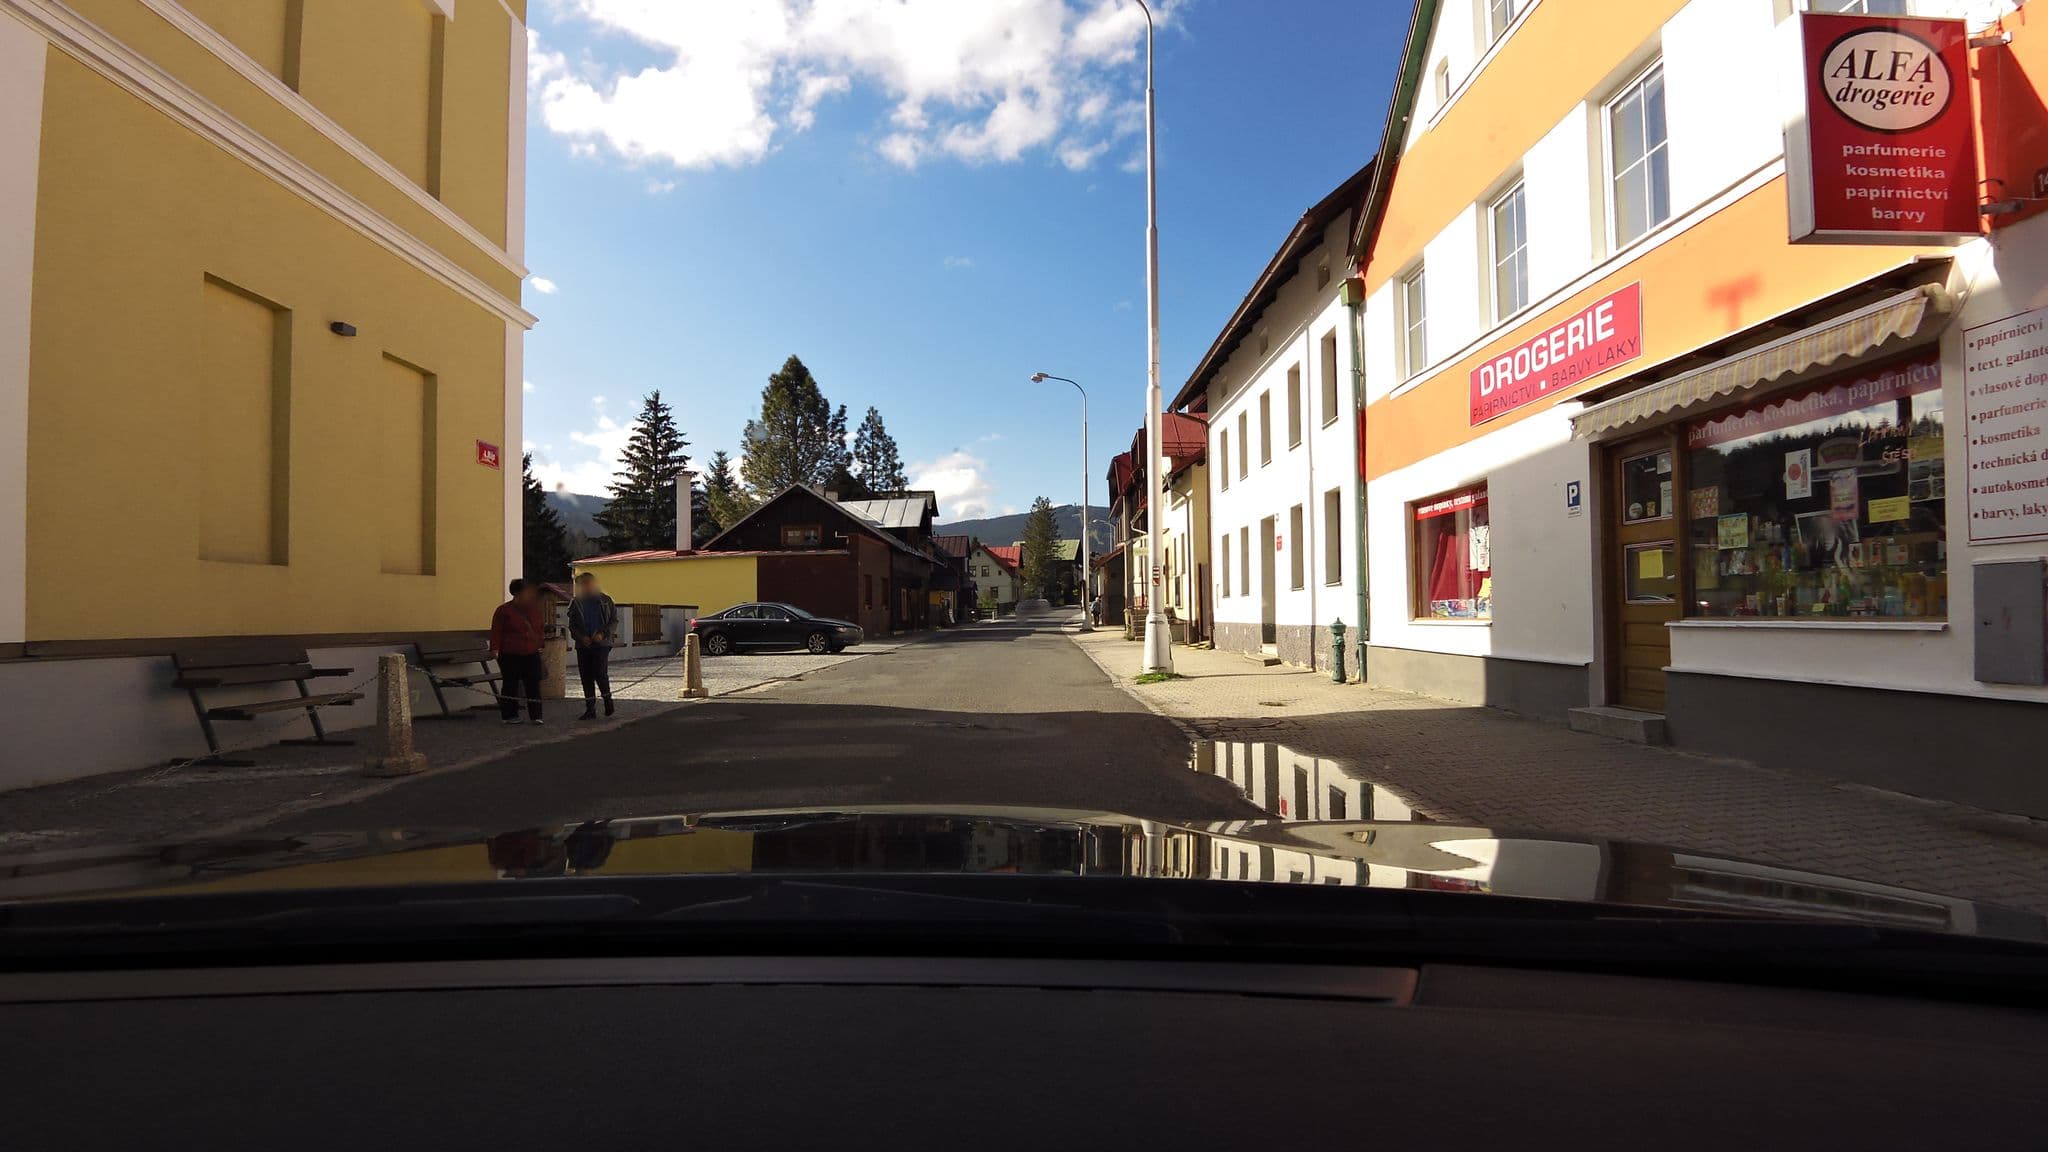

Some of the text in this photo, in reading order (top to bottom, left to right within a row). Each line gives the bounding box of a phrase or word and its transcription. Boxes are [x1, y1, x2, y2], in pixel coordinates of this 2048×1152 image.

[1831, 48, 1934, 83] ALFA
[1835, 81, 1935, 111] drogerie
[1842, 143, 1946, 157] parfumerie
[1846, 164, 1946, 179] kosmetika
[1871, 207, 1926, 223] barvy
[1479, 300, 1615, 397] DROGERIE
[1551, 357, 1592, 387] BARVY
[1597, 336, 1638, 366] LAKY
[1978, 357, 2003, 372] text.
[1978, 375, 2022, 396] vlasové
[1979, 397, 2048, 425] parfumerie
[1980, 425, 2041, 446] kosmetika
[1980, 449, 2037, 470] technická
[1569, 484, 1578, 504] P
[1981, 508, 2019, 521] barvy,
